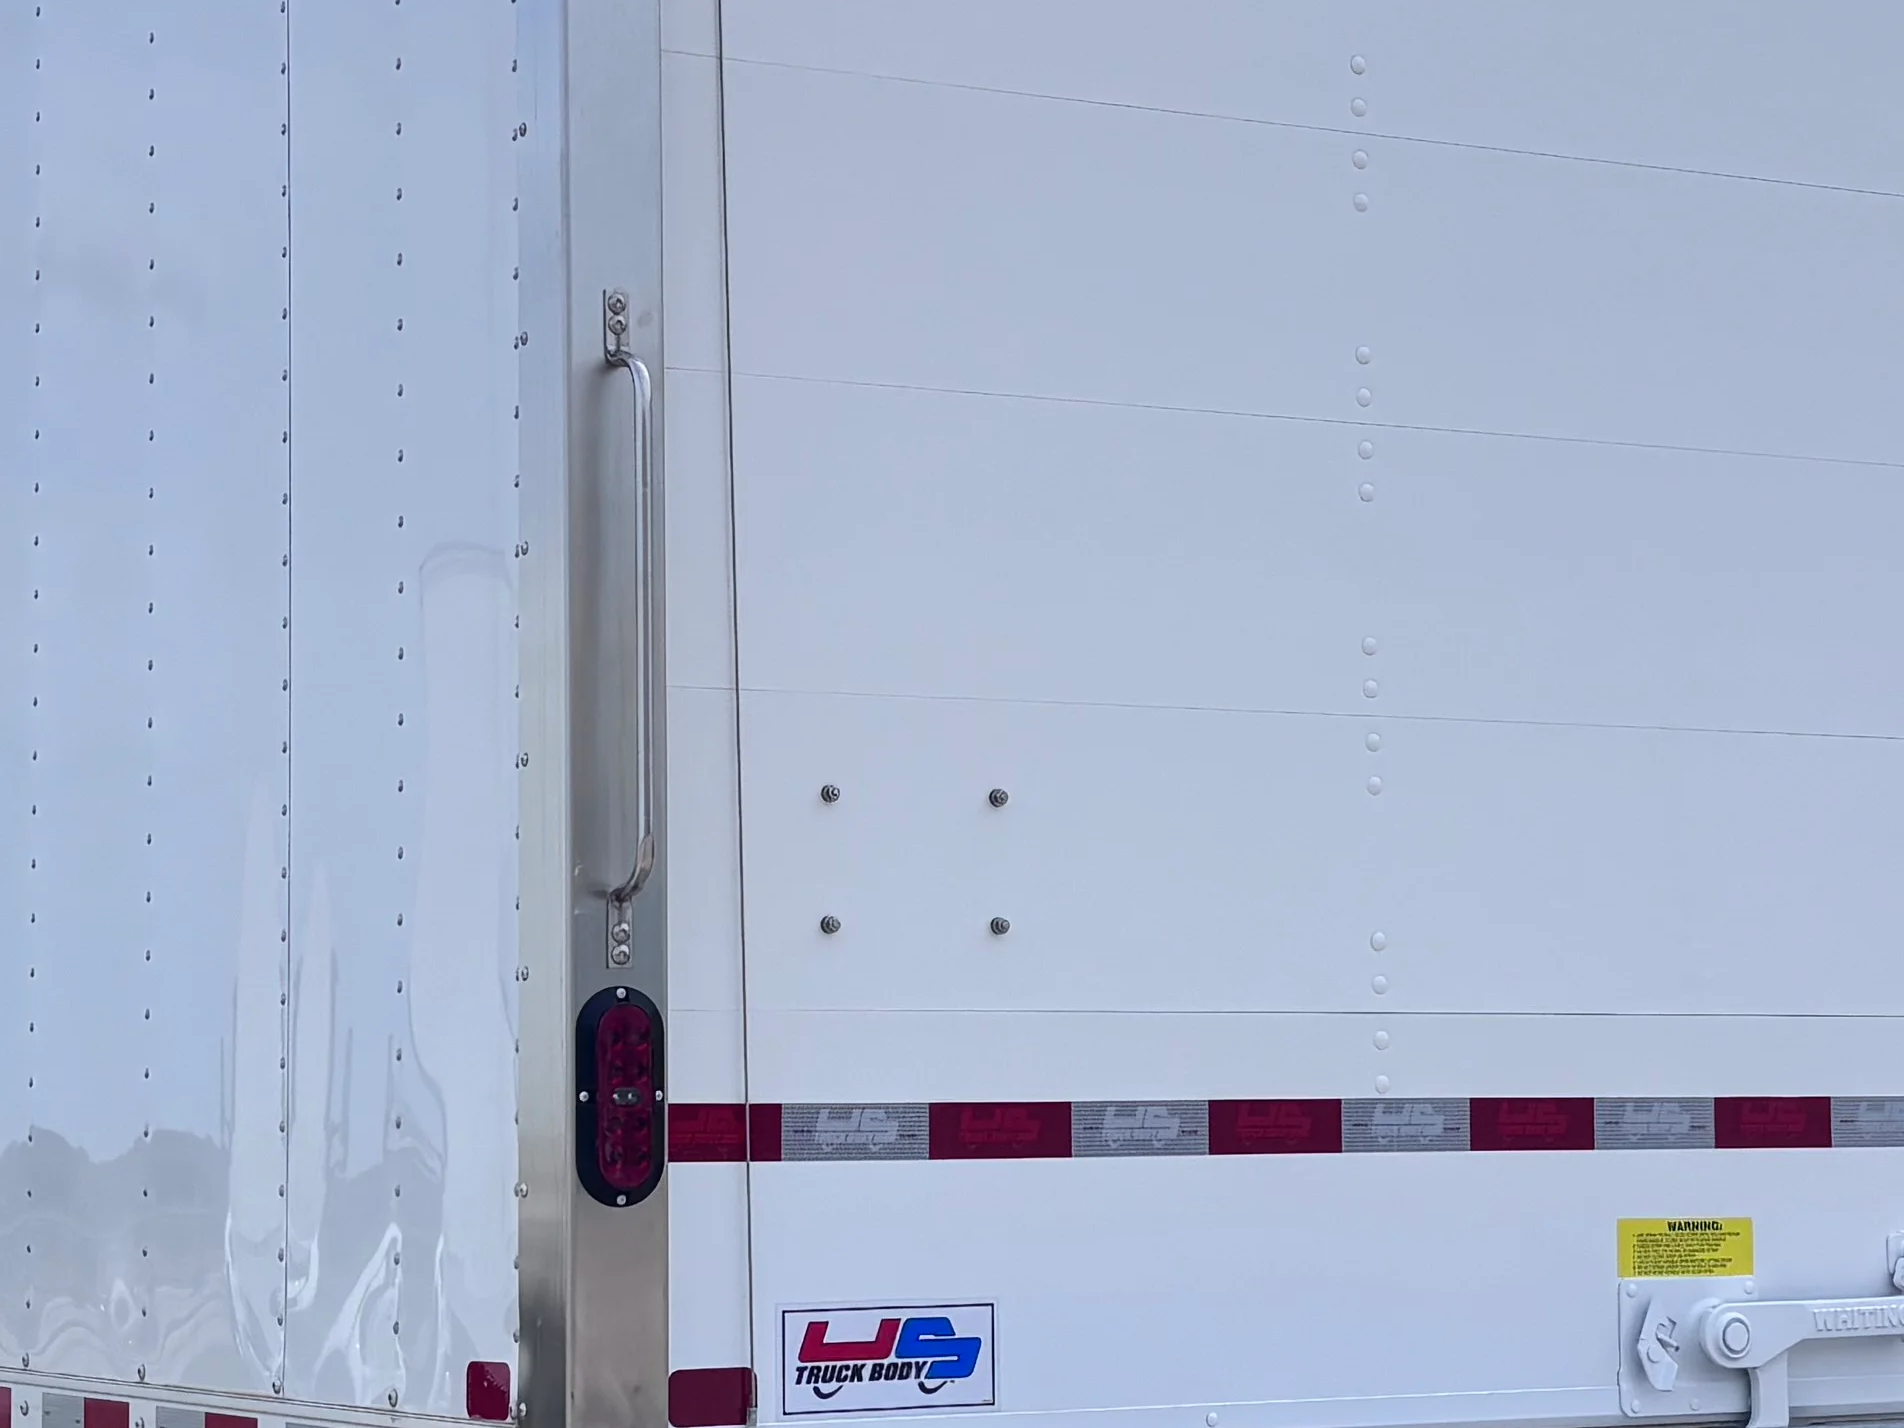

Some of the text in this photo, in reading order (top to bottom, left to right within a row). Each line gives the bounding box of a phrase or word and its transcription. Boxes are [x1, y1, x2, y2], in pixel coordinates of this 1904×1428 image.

[798, 1317, 982, 1380] US
[795, 1360, 928, 1386] TRUCK BODY
